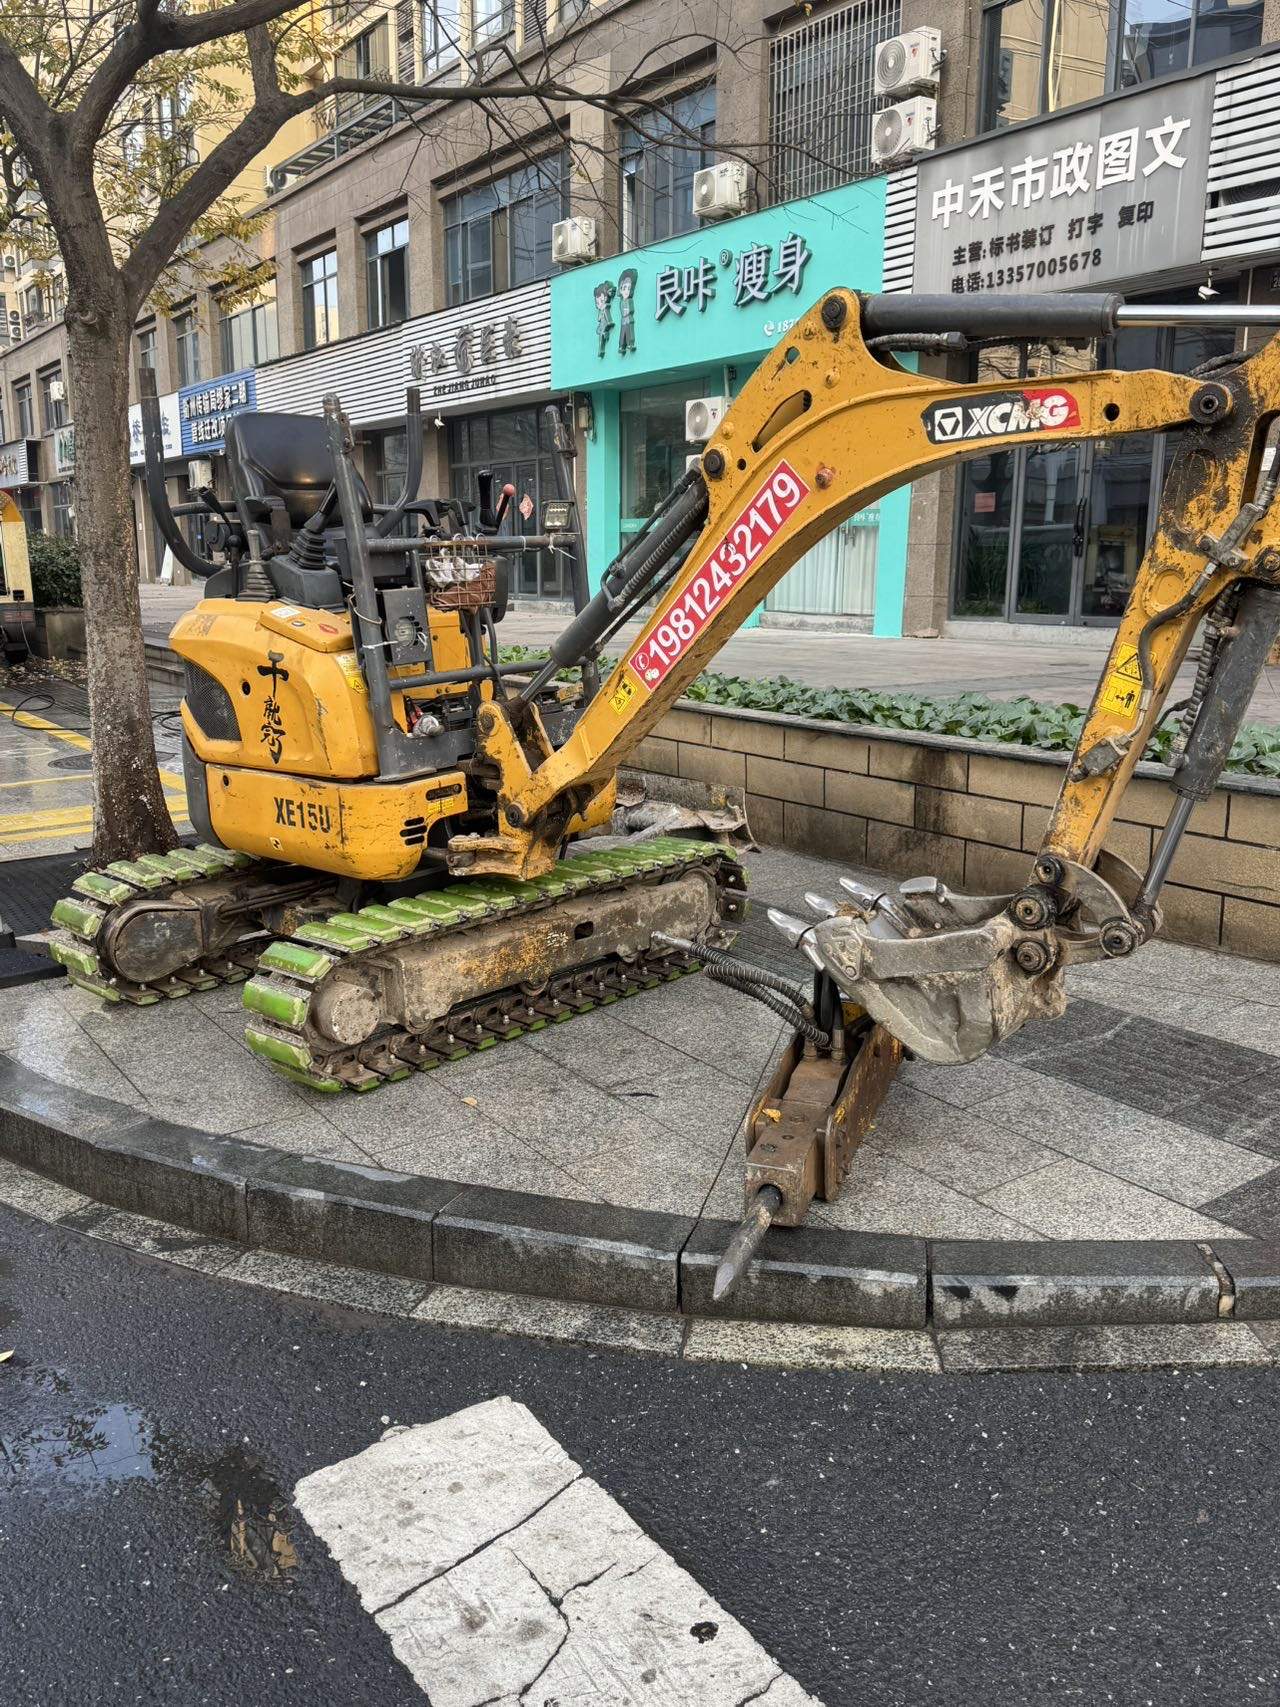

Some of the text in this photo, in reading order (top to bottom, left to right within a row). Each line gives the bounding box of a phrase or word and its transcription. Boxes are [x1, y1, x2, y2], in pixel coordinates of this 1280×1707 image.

[931, 115, 1191, 229] 中禾市政图文
[963, 395, 1070, 437] XCMG
[648, 472, 801, 666] 19812432179
[273, 797, 330, 834] XE15U
